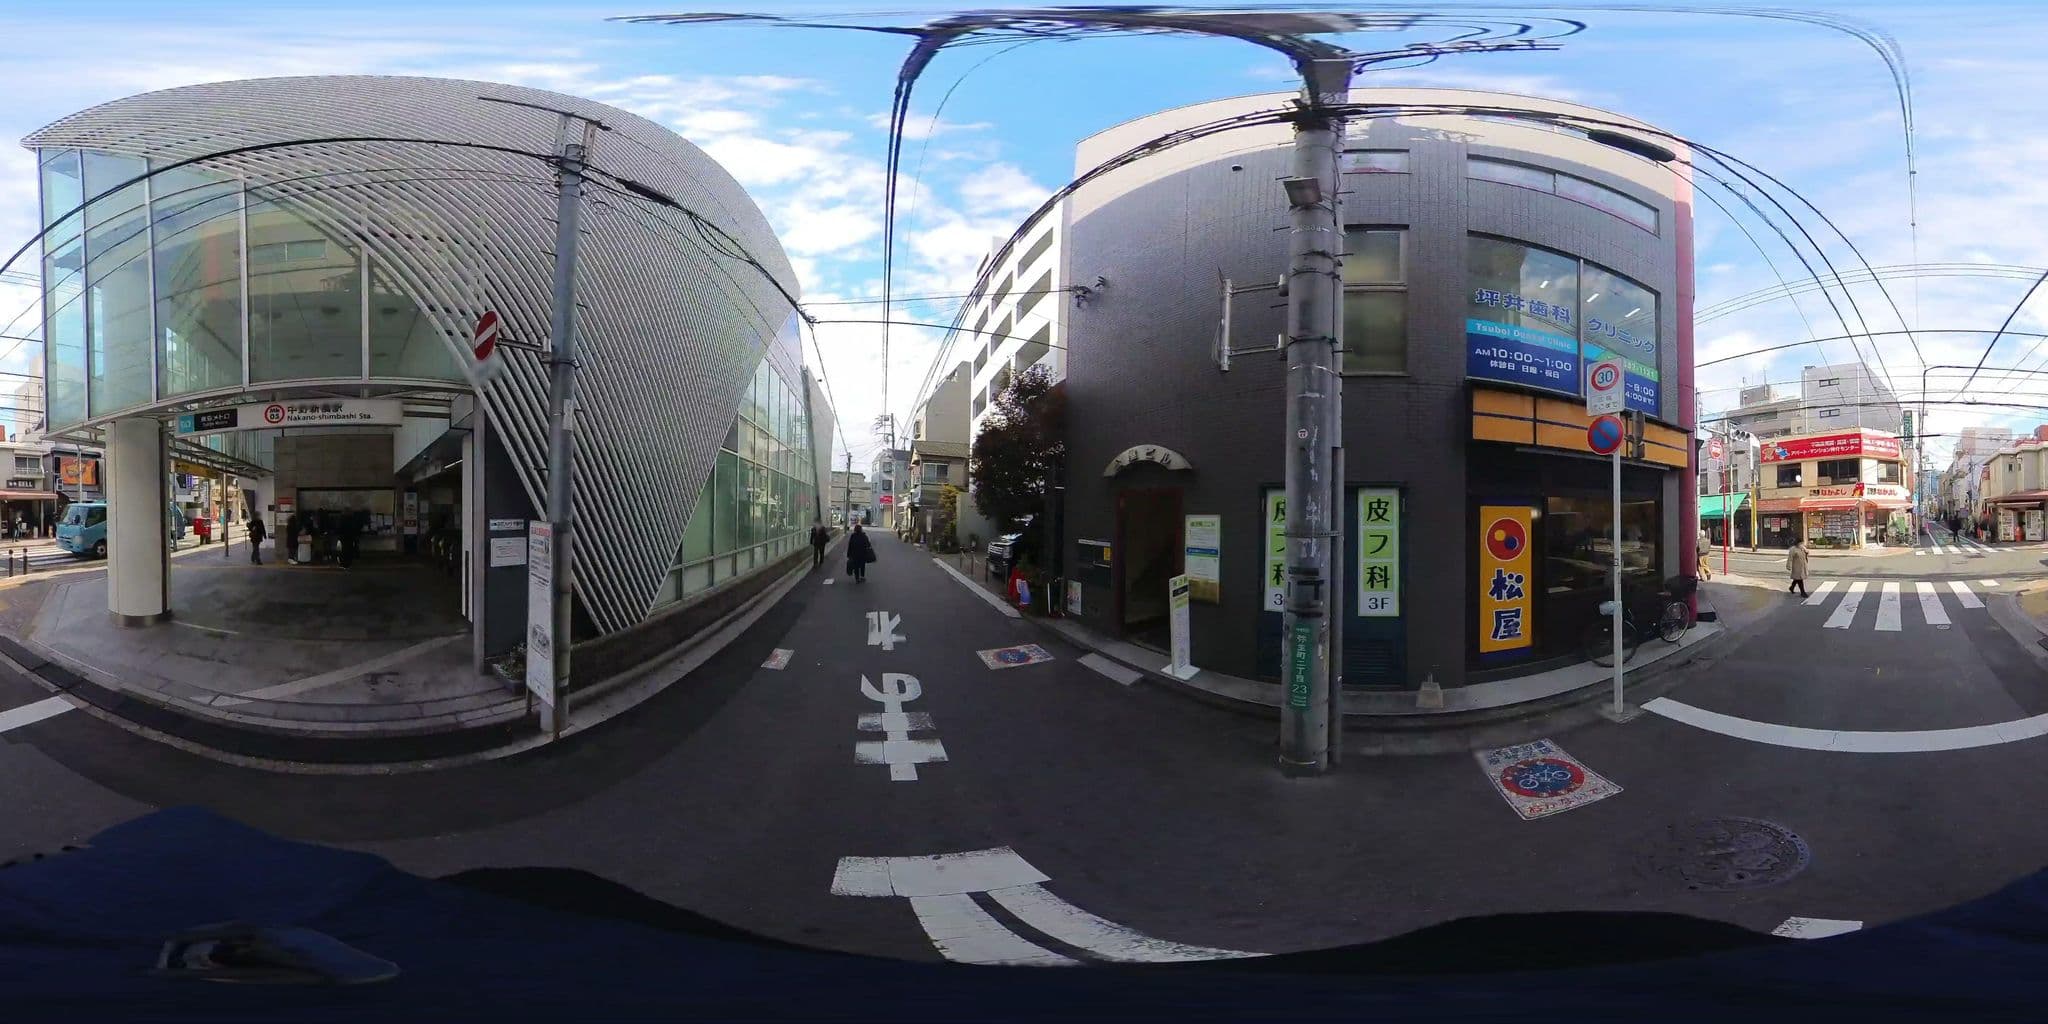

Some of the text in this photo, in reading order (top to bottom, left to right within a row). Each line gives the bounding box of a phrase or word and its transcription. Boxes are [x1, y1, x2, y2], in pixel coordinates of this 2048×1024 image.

[1475, 288, 1655, 353] 坪井歯科 クリニック
[1597, 370, 1614, 384] 30
[287, 412, 356, 422] Nakano-shimbashi
[1366, 498, 1391, 590] 皮フ科
[1367, 597, 1391, 610] 3F
[1488, 567, 1525, 641] 松屋
[1291, 684, 1308, 694] 23
